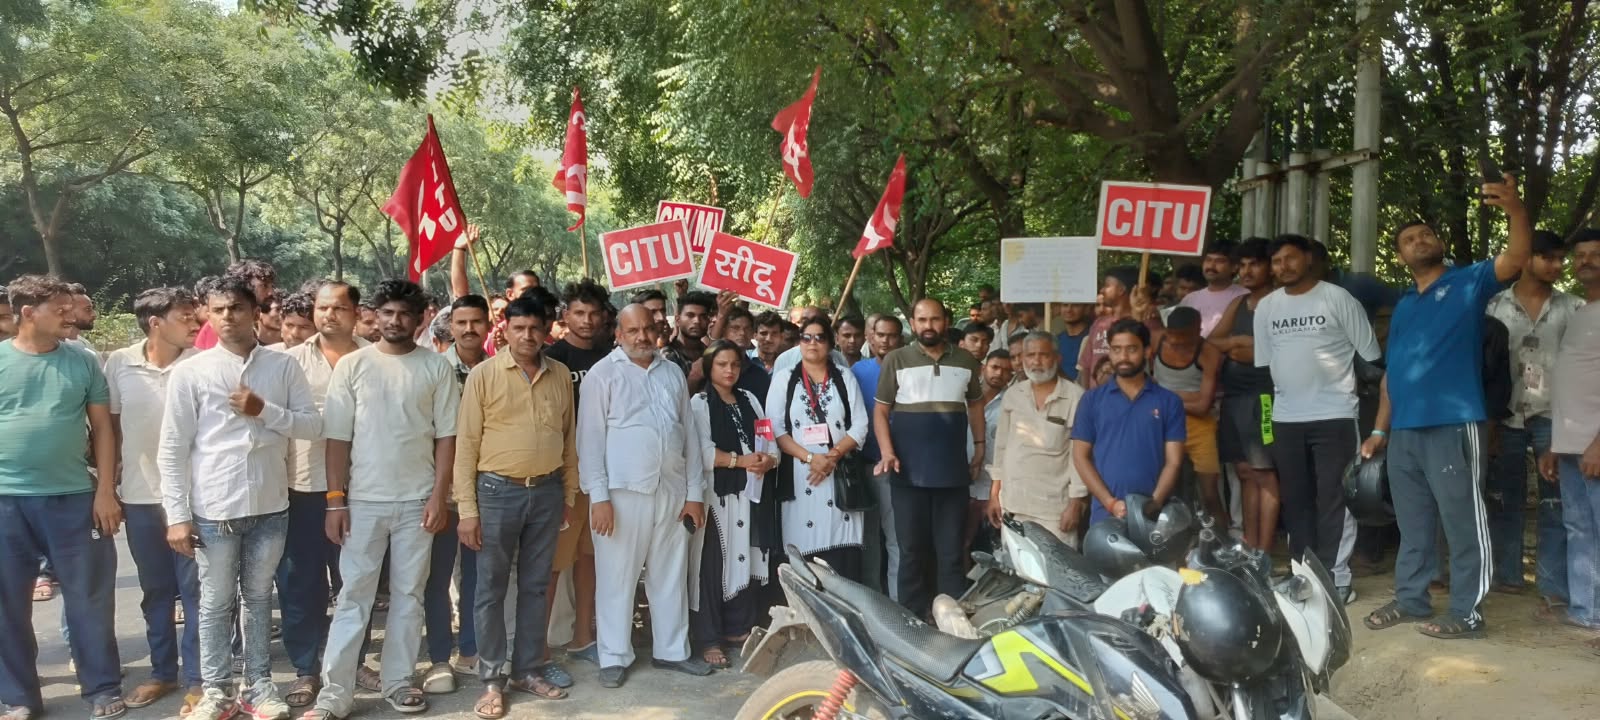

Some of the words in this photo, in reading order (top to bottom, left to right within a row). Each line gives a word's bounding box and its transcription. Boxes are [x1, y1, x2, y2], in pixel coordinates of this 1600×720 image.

[430, 146, 458, 233] ITU
[1107, 198, 1200, 241] CITU
[609, 231, 686, 276] CITU
[714, 245, 777, 301] सीटू
[1272, 315, 1326, 330] NARUTO
